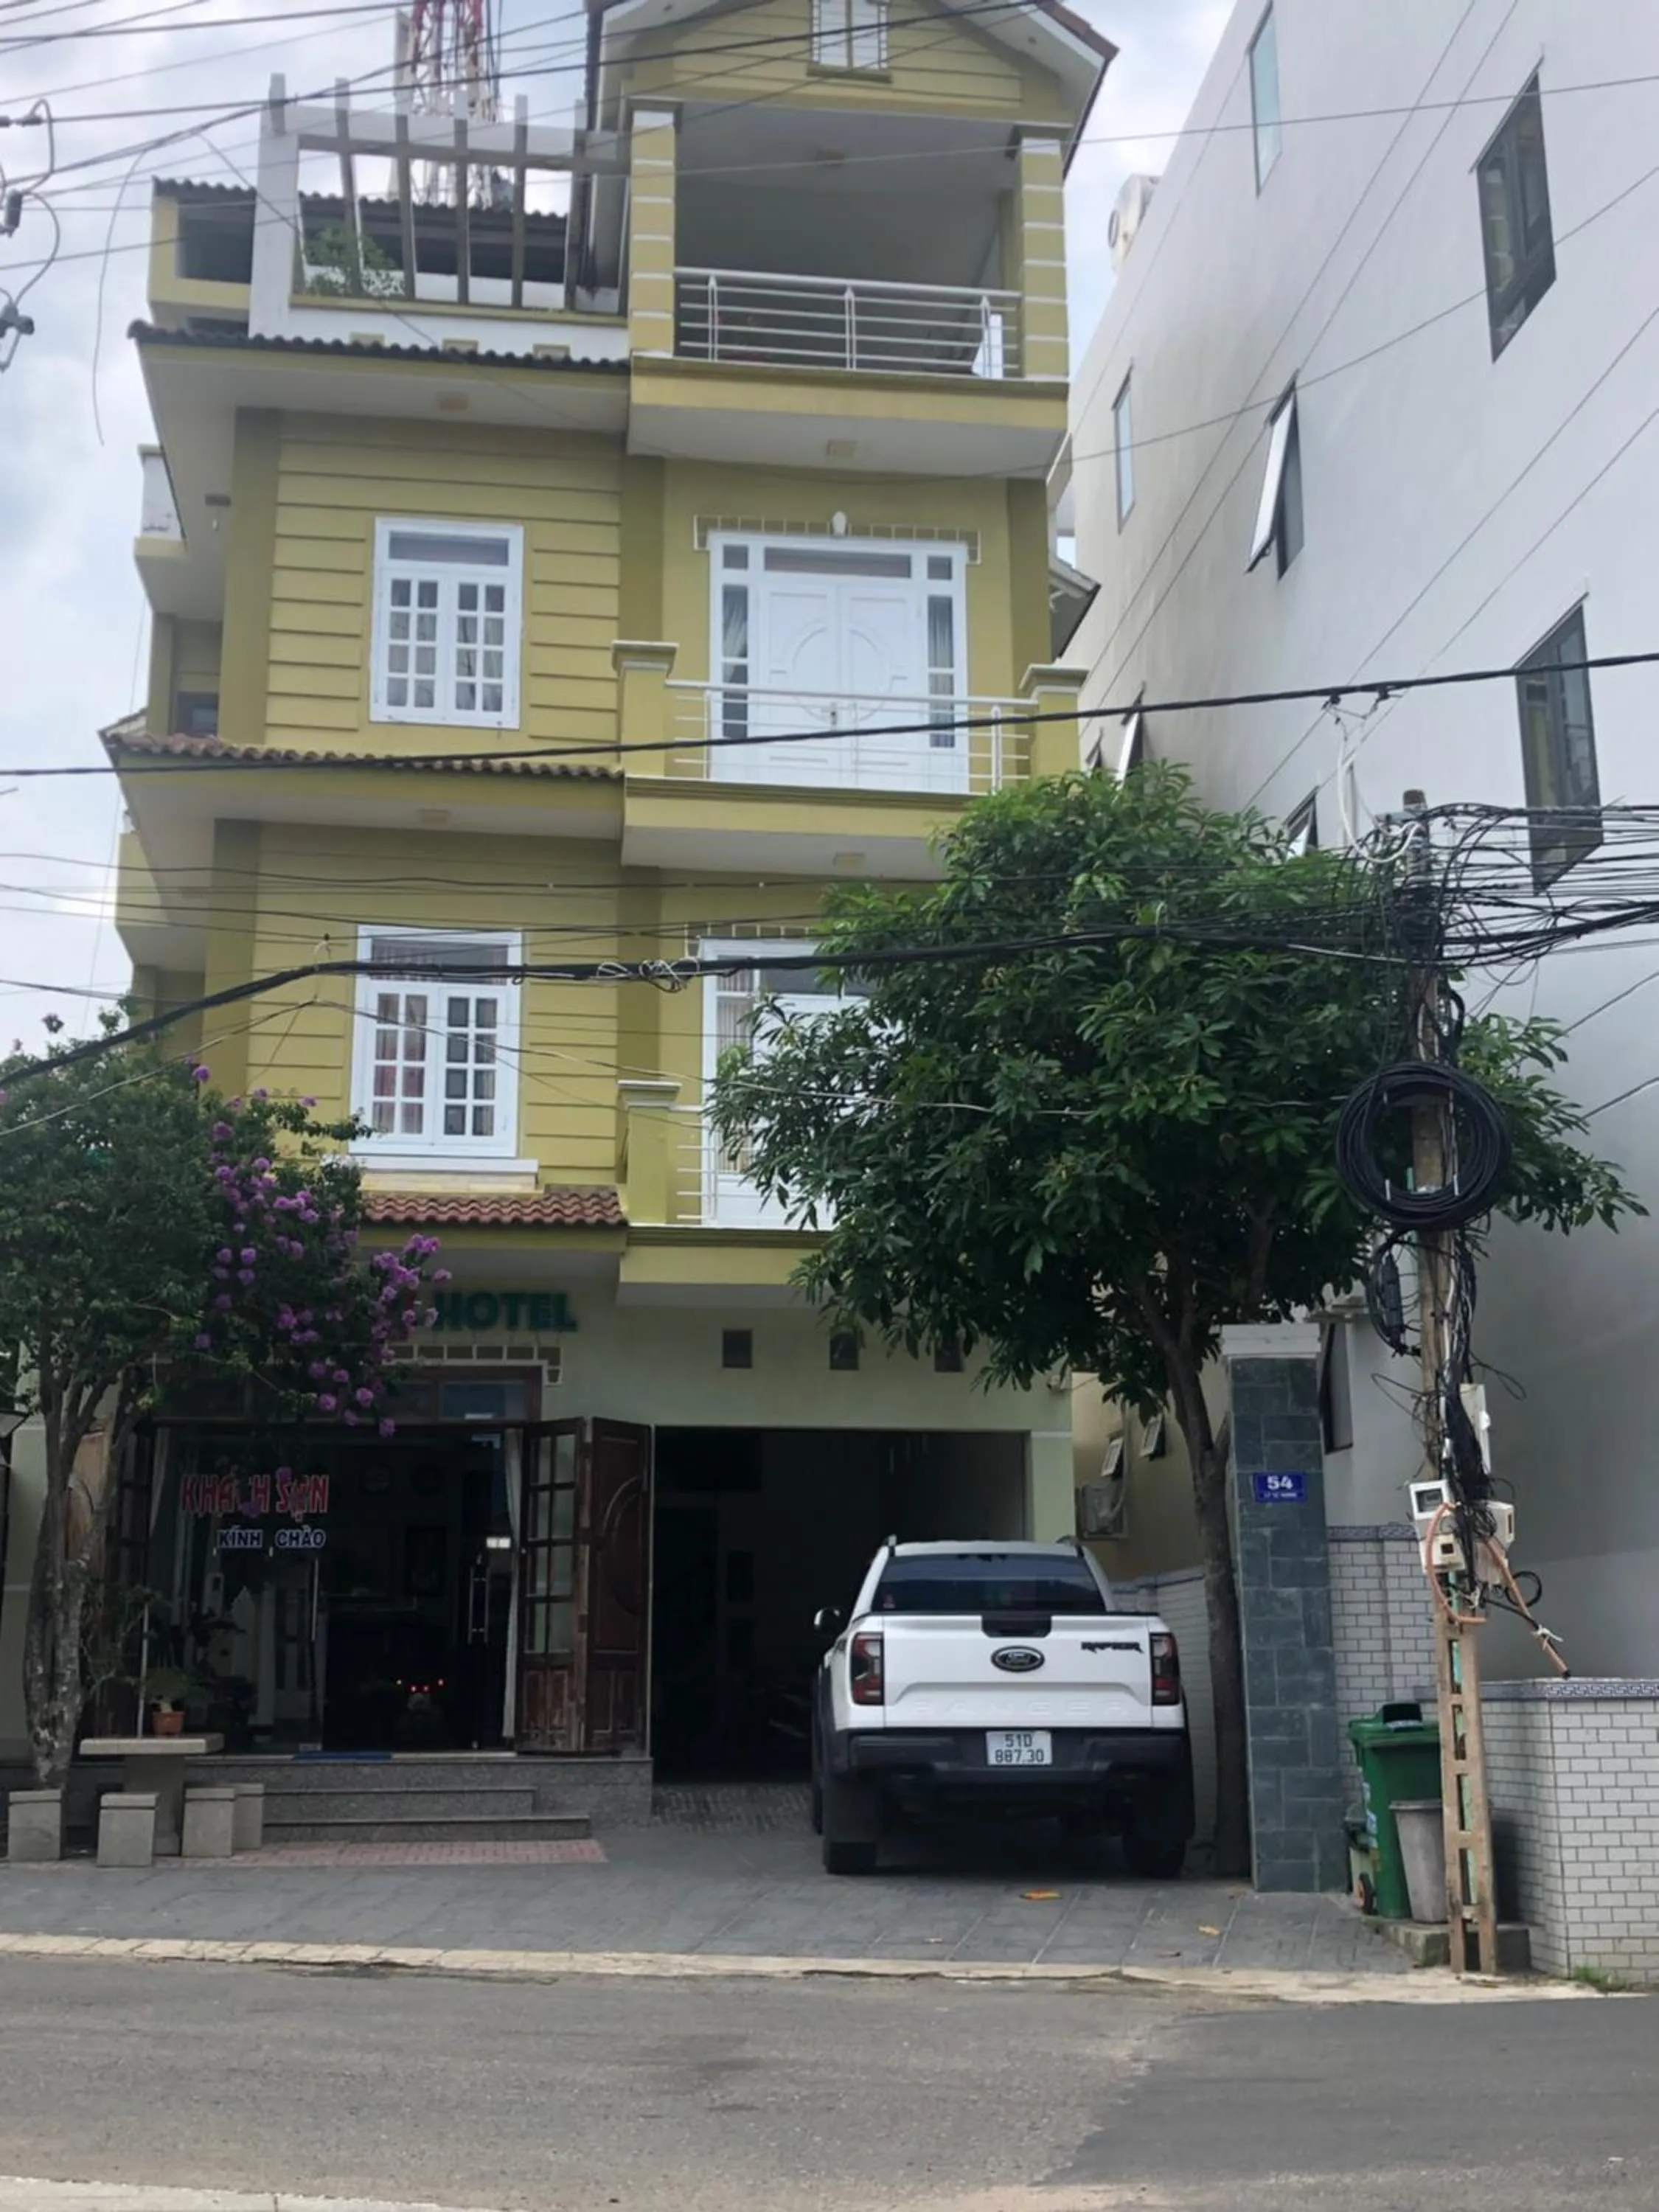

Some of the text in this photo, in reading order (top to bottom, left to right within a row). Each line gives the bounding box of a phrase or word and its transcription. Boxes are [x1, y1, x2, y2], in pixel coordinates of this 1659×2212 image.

[432, 1291, 579, 1332] HOTEL
[1267, 1475, 1293, 1490] 54
[217, 1524, 263, 1548] KÍNH
[1004, 1733, 1033, 1747] 51D
